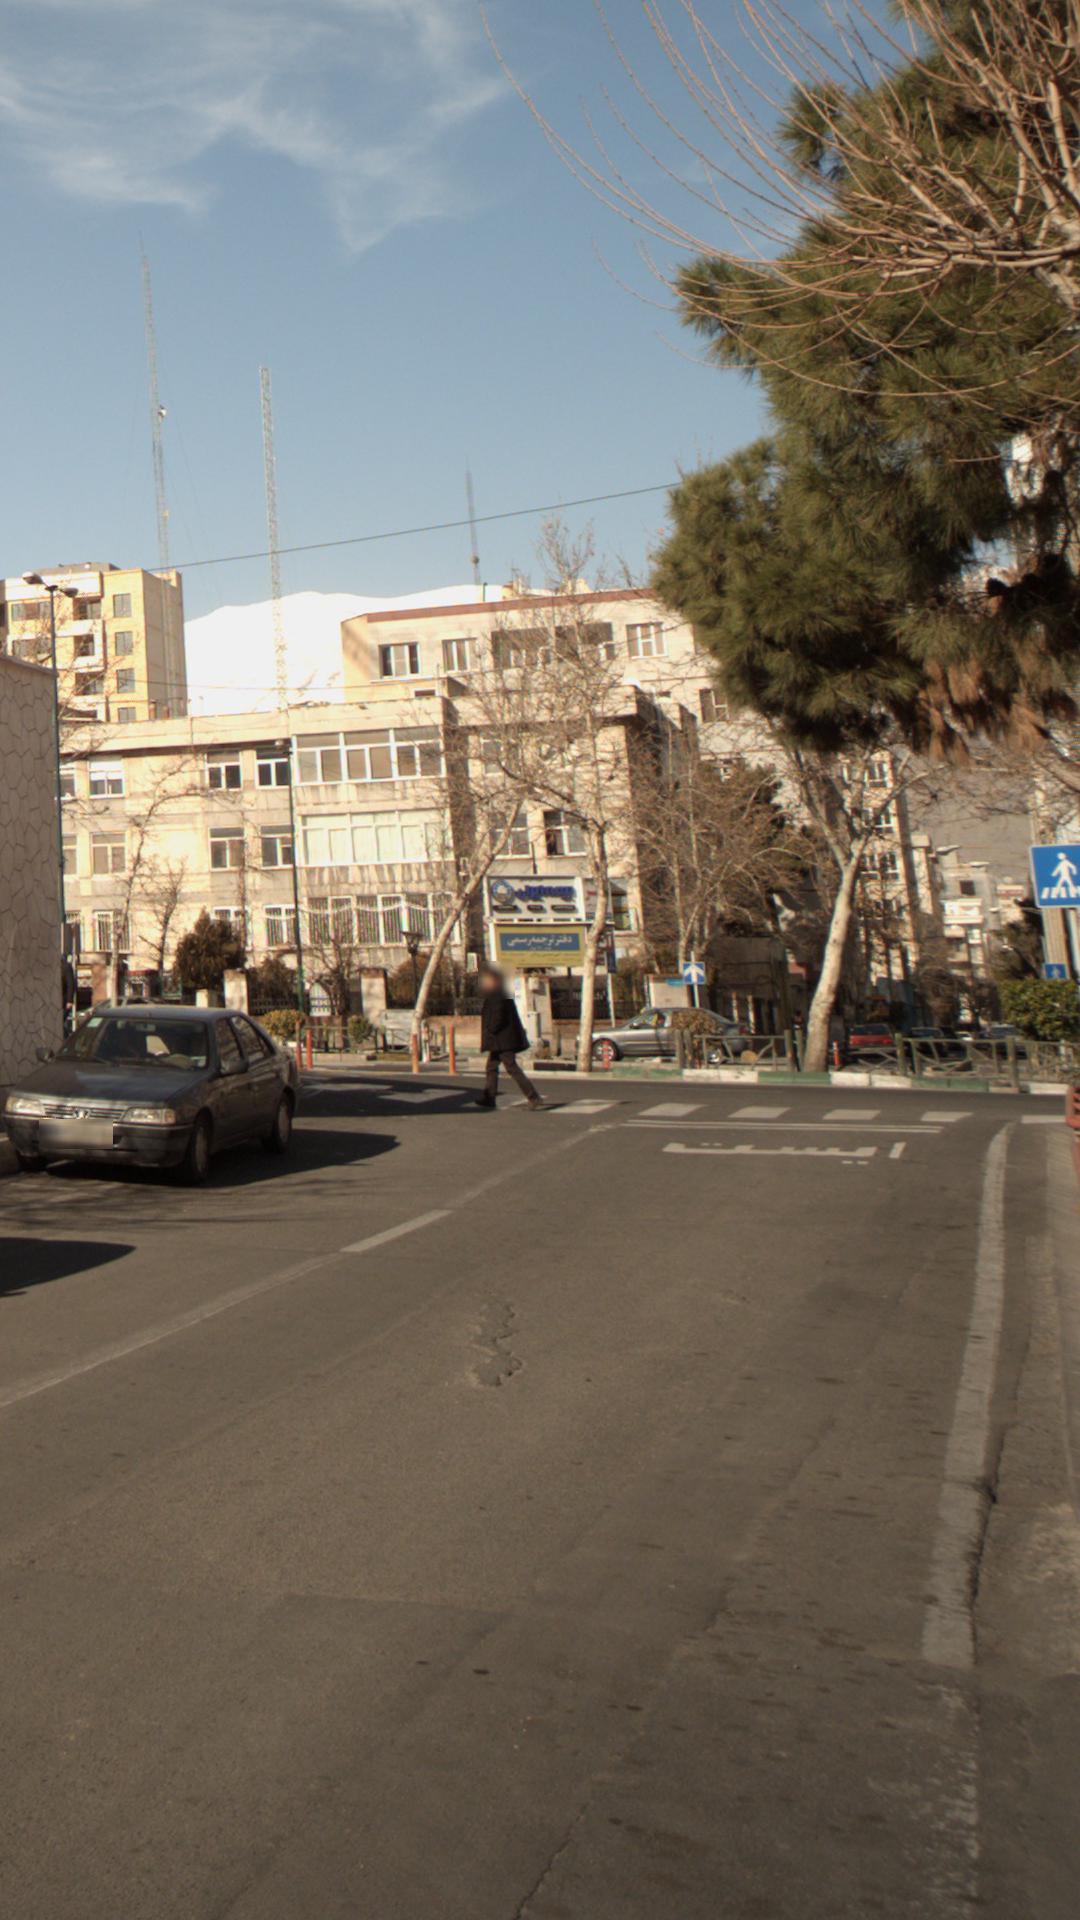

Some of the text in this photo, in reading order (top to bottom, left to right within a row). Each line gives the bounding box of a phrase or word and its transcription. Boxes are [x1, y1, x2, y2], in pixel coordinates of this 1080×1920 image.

[532, 934, 554, 947] ترجمه
[555, 934, 573, 947] دفتر
[662, 1141, 906, 1165] ایست
